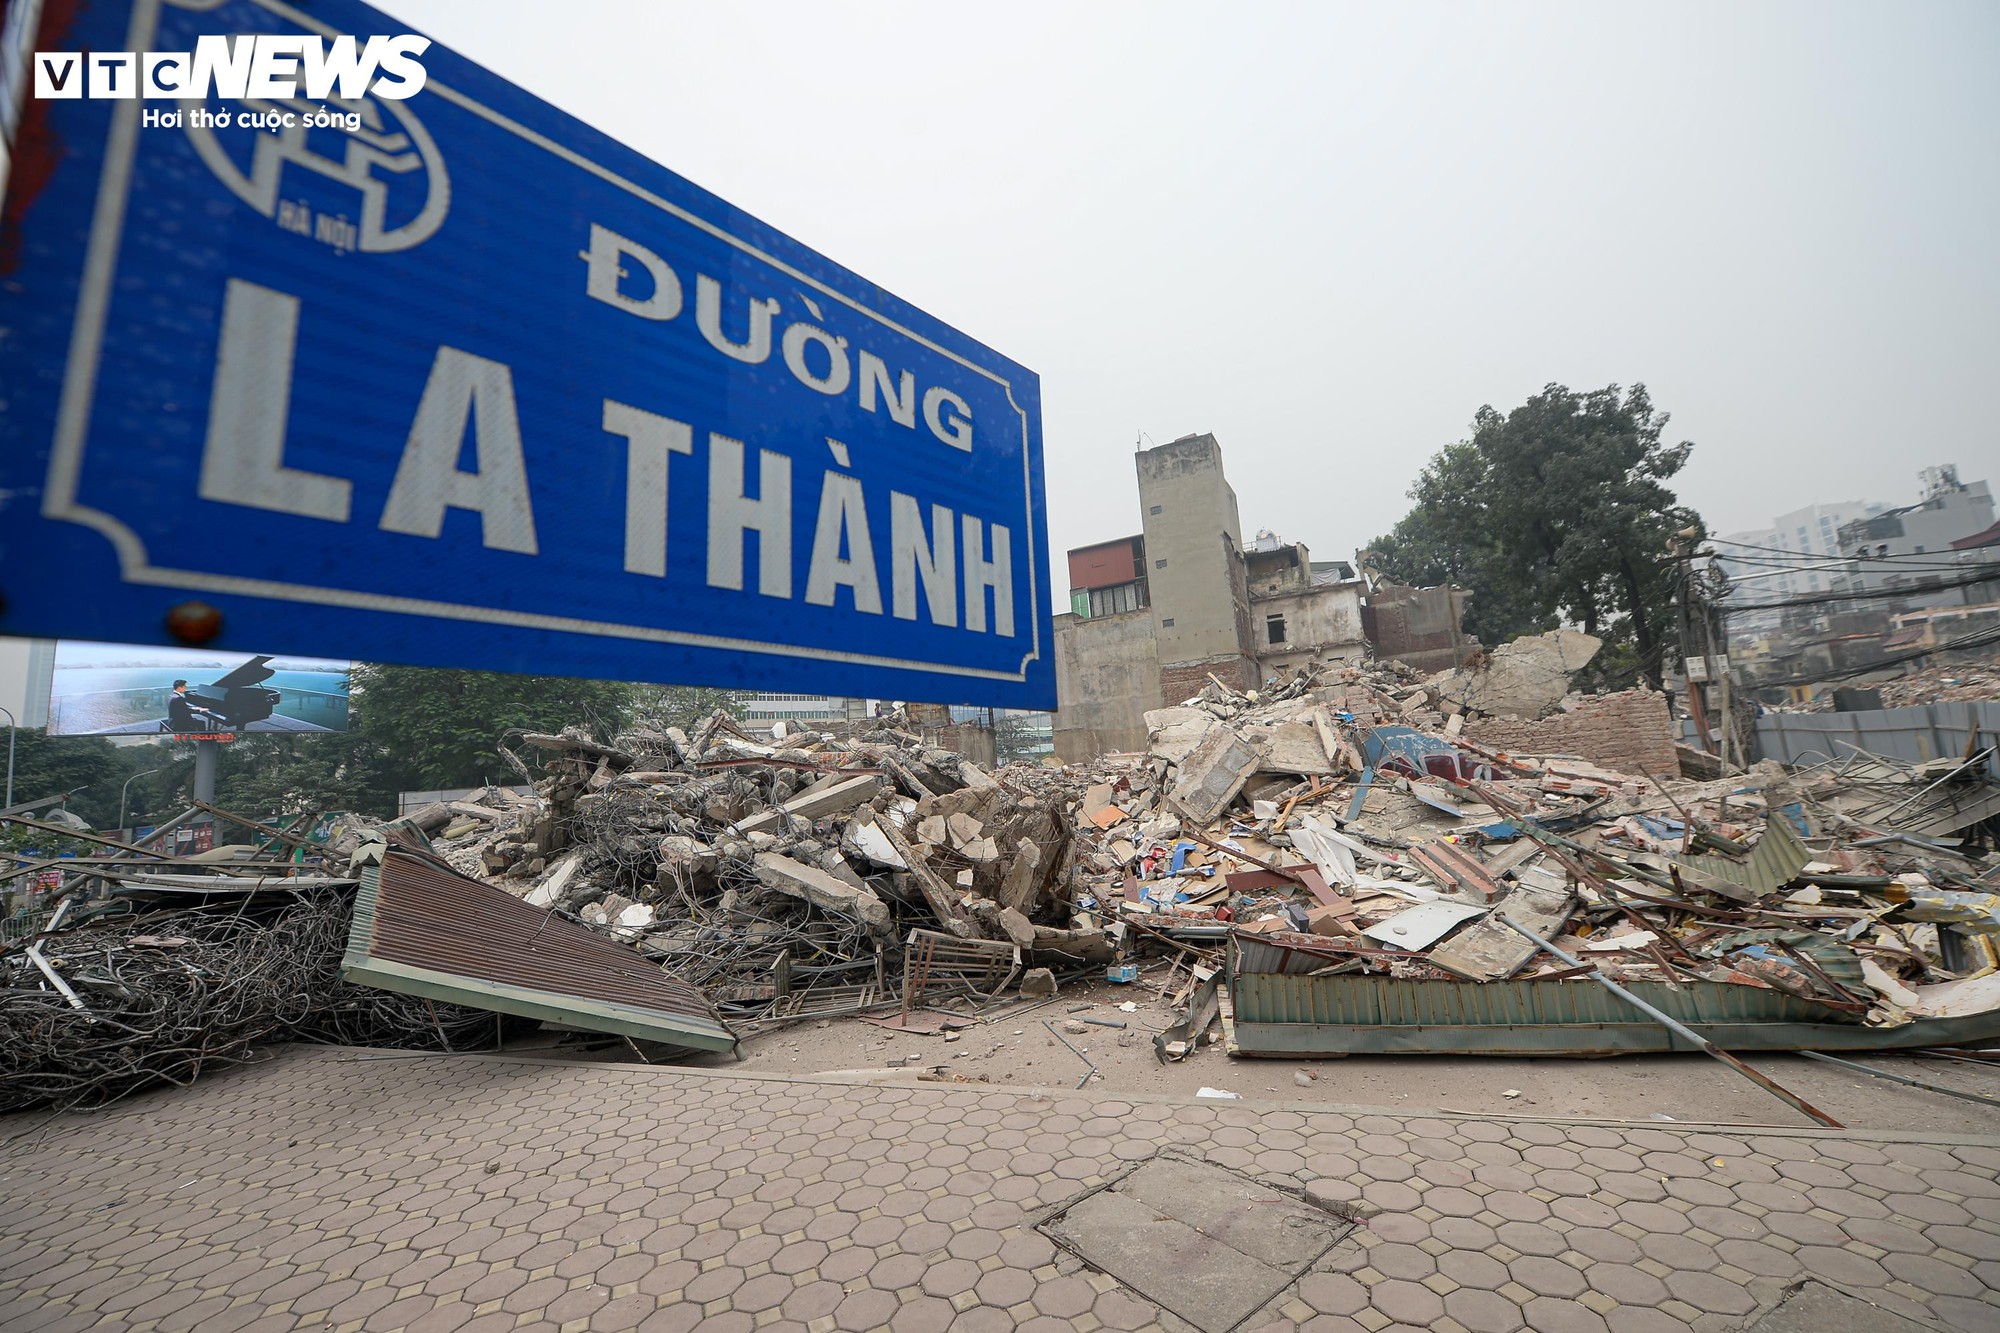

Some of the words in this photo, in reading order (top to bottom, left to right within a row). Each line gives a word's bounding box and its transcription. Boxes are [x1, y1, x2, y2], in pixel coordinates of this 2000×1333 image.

[199, 277, 539, 556] LA
[602, 398, 1015, 638] THÀNH
[579, 223, 973, 453] ĐƯỜNG
